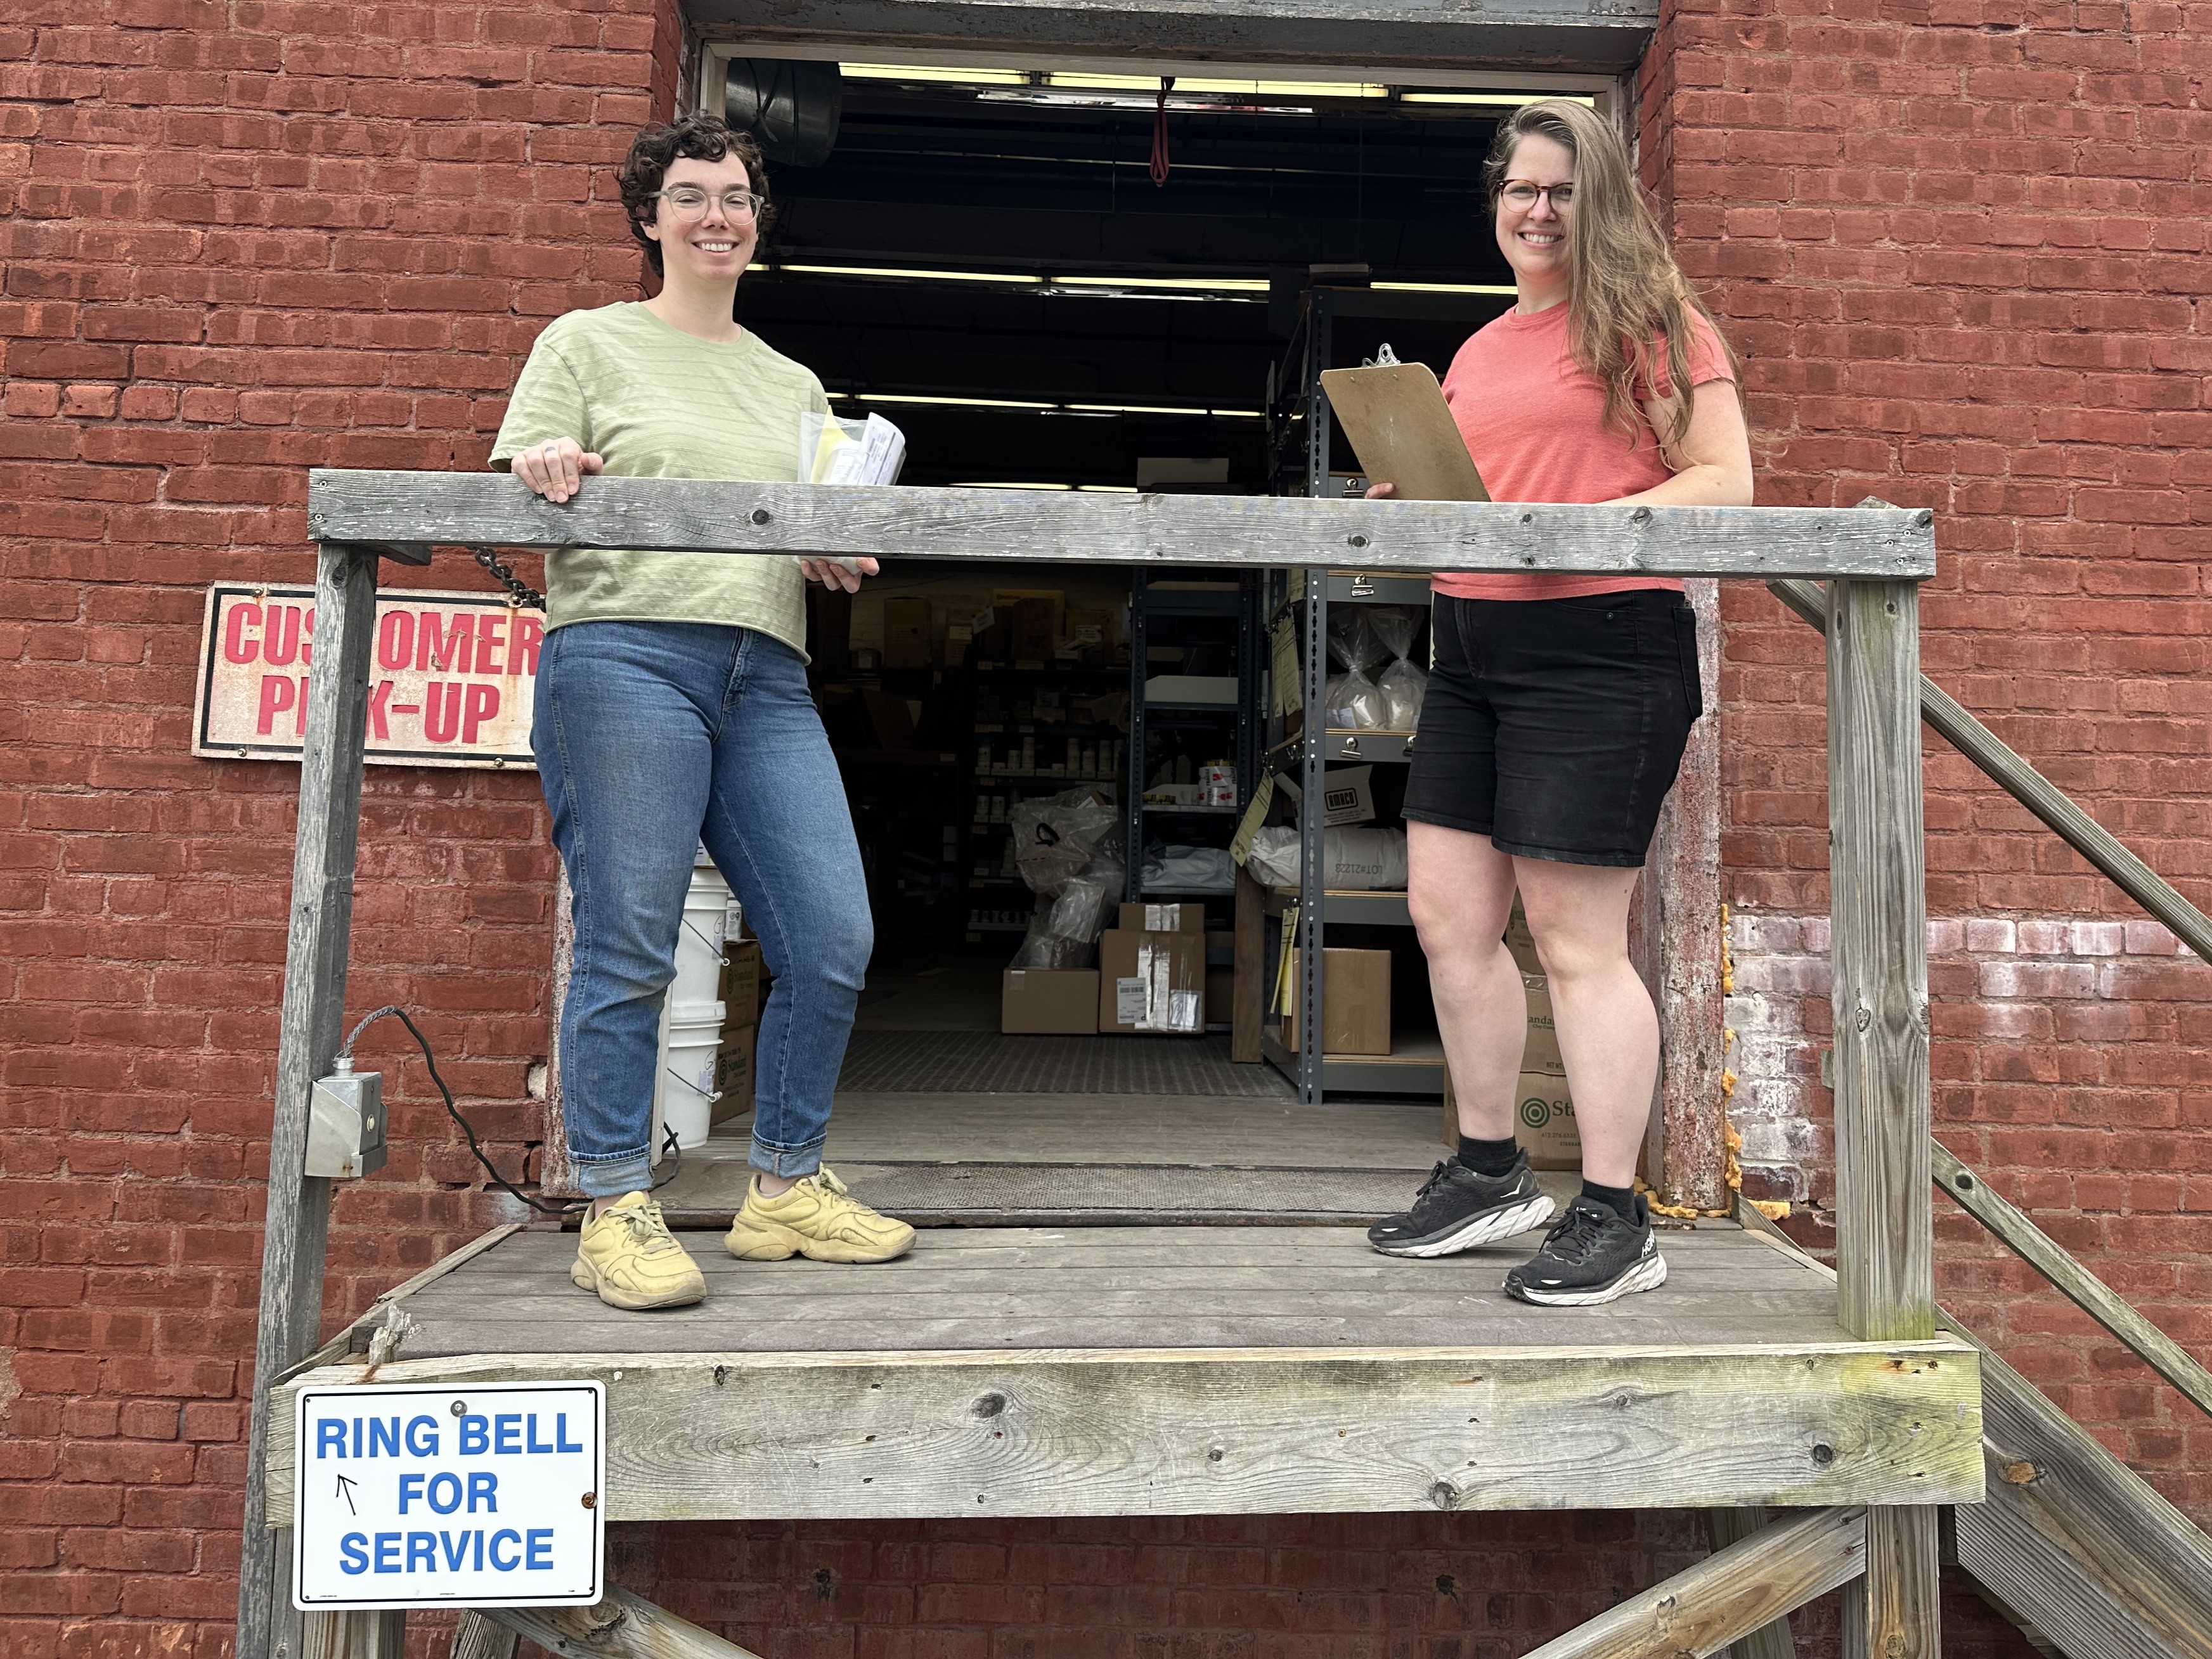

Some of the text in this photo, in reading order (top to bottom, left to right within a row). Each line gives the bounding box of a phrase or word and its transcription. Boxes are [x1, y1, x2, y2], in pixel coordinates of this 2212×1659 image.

[224, 602, 545, 676] CUOMER
[256, 675, 501, 744] PIK-UP
[1328, 791, 1355, 808] AMACO
[316, 1412, 583, 1459] RING BELL
[398, 1471, 499, 1515] FOR
[339, 1528, 554, 1575] SERVICE
